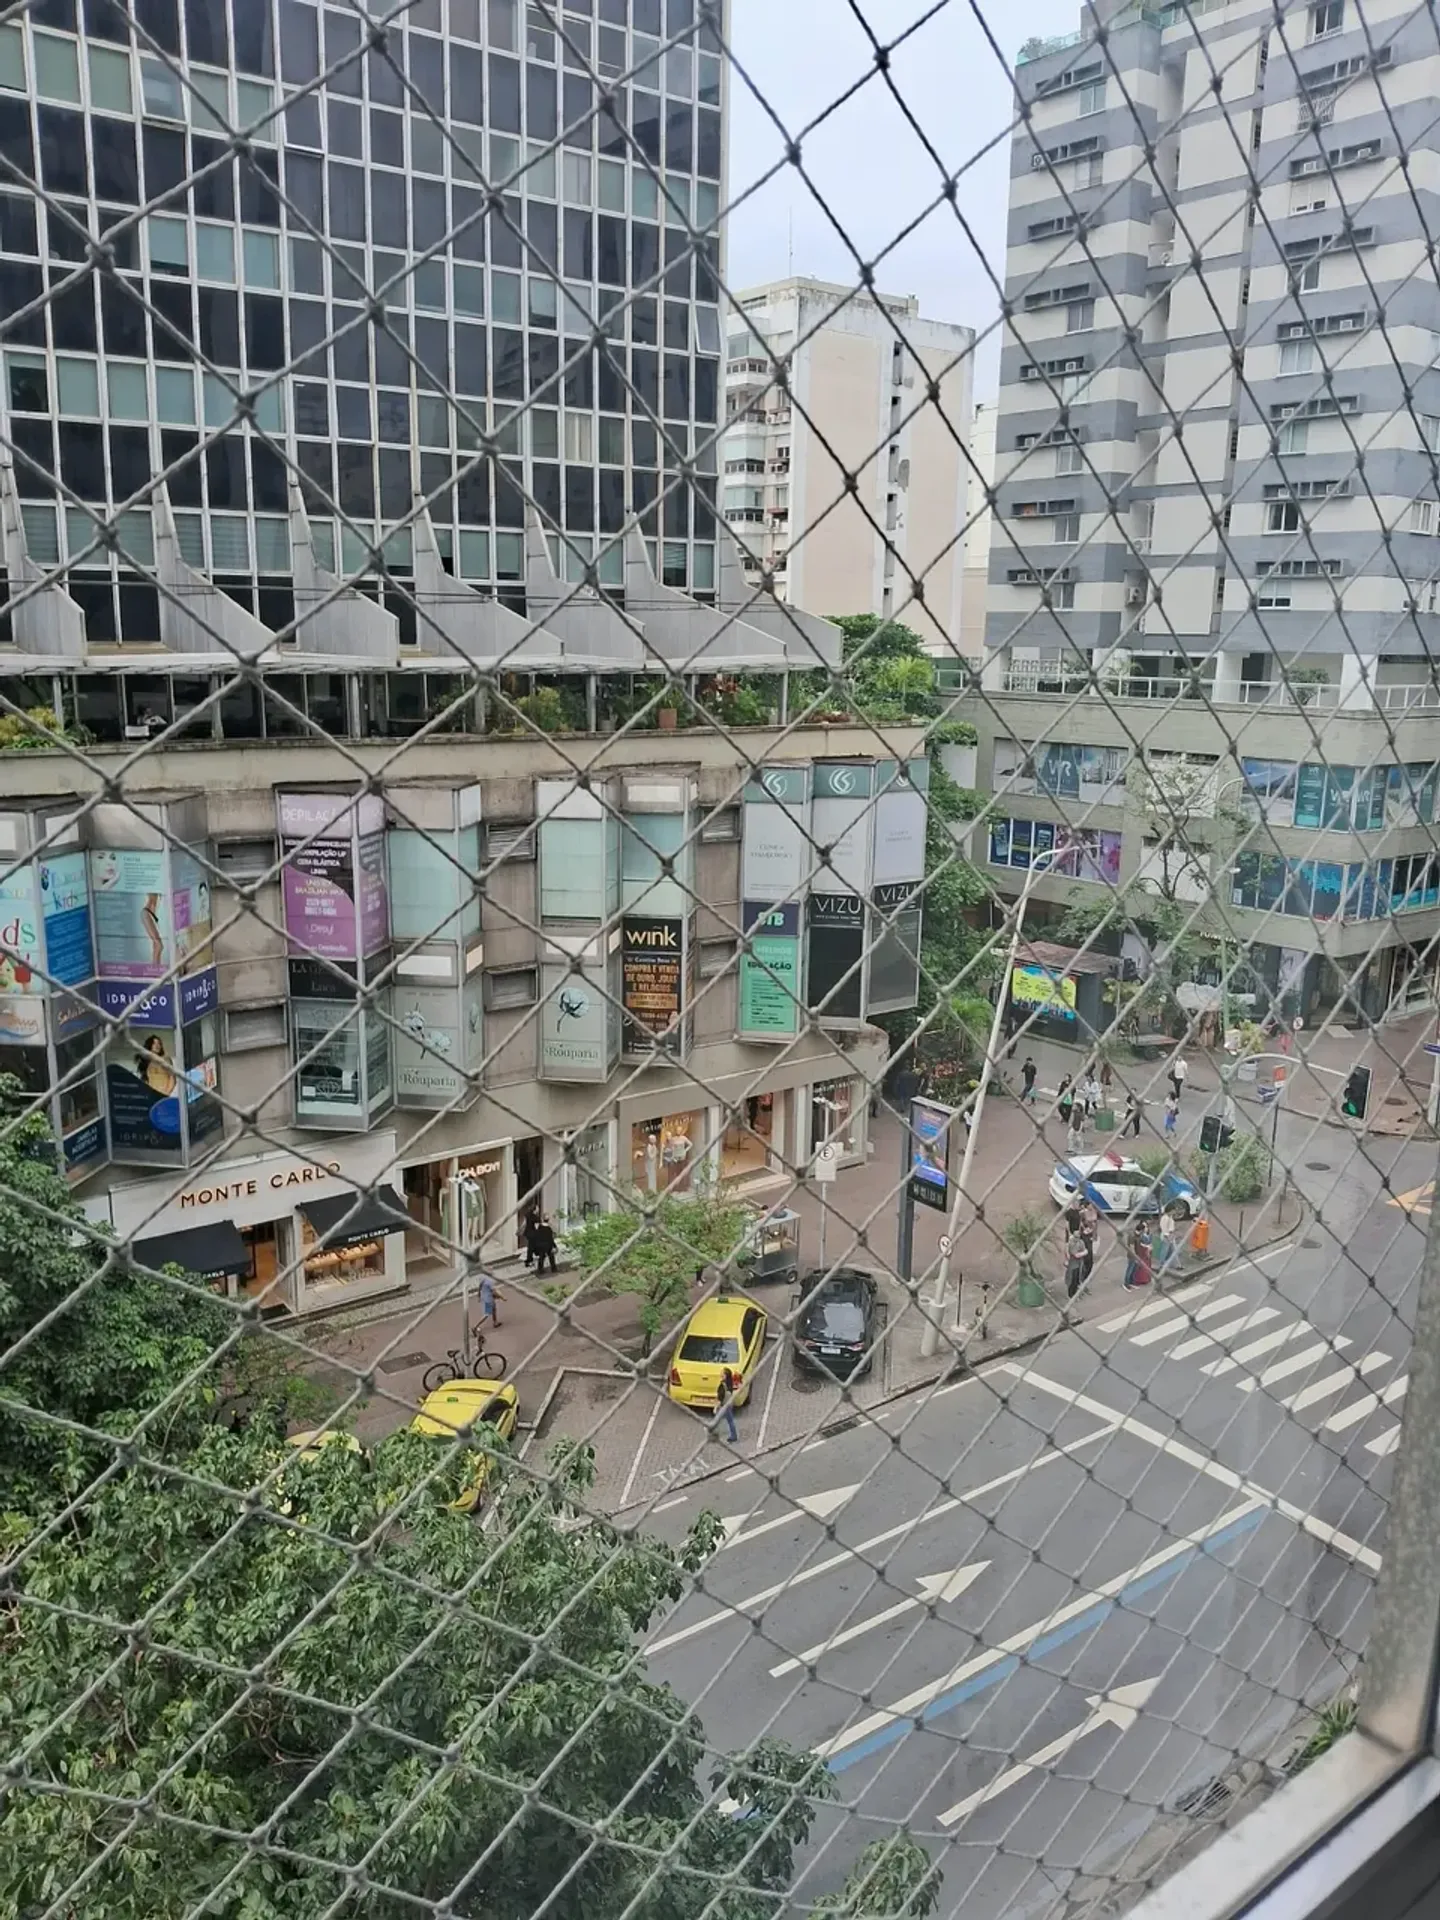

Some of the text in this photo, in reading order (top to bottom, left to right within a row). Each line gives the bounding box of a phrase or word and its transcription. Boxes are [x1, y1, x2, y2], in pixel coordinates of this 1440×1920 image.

[815, 897, 862, 914] VIZU
[626, 925, 678, 947] wink
[181, 1162, 342, 1209] MONTE CARLO
